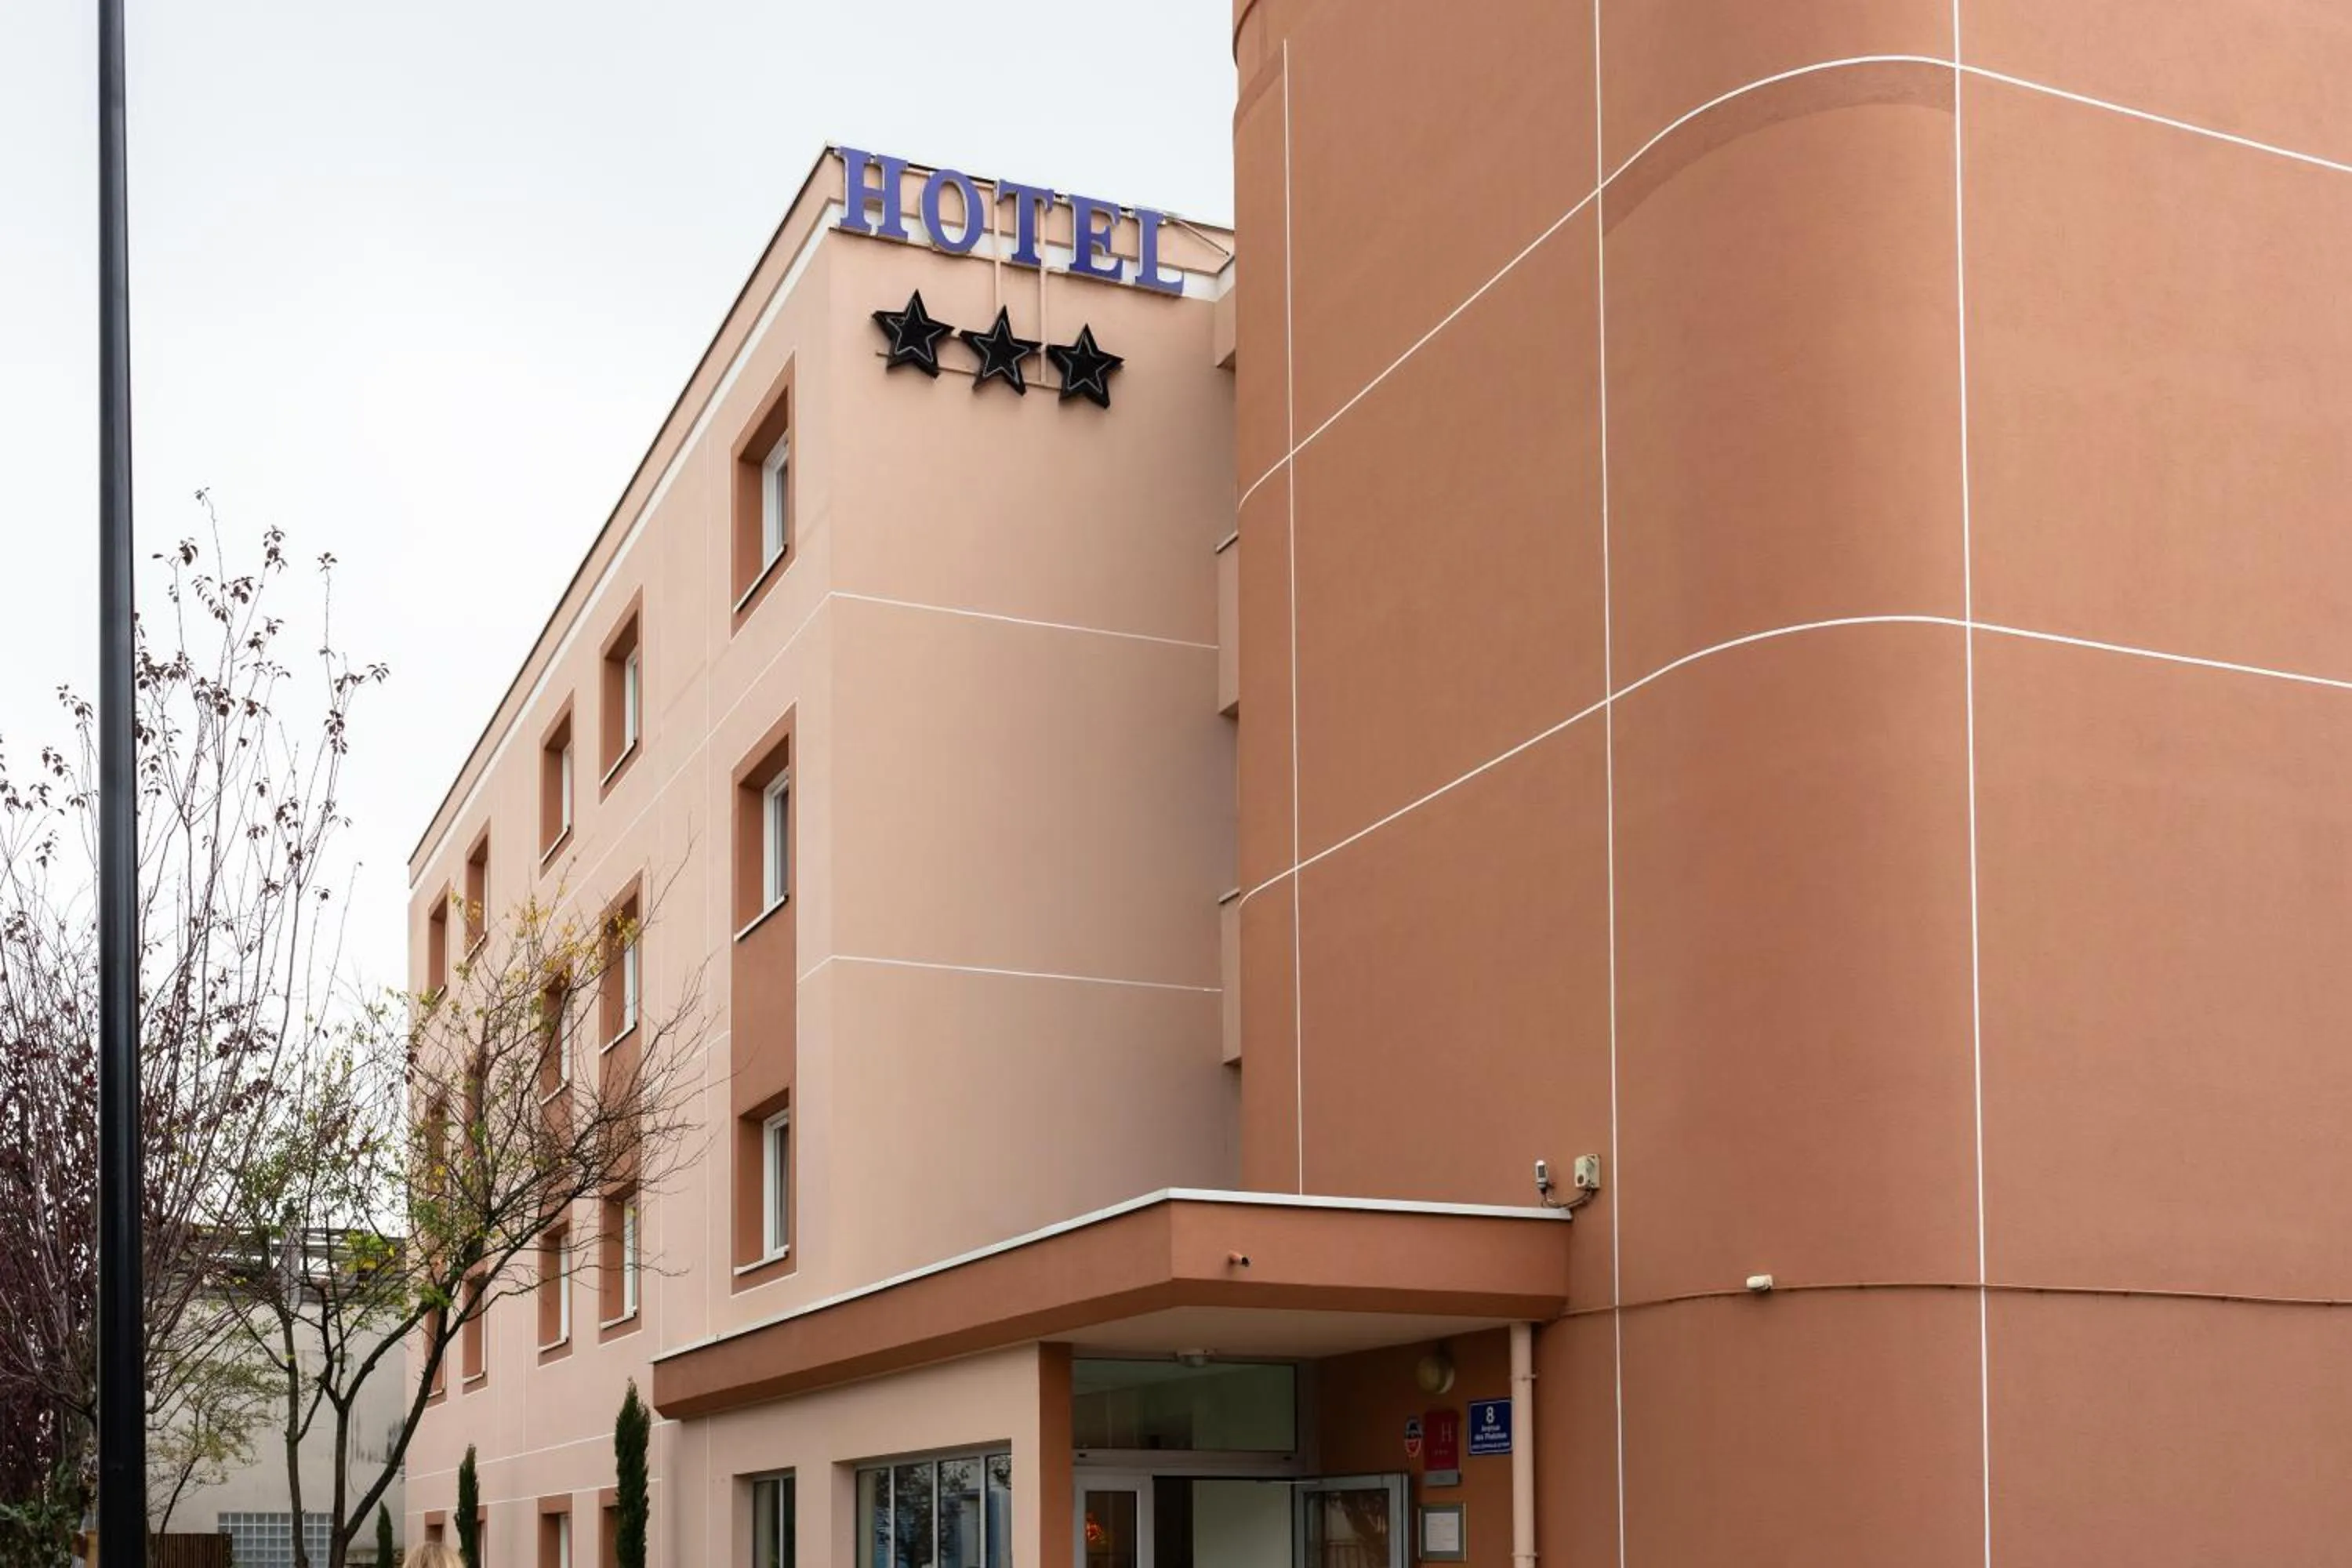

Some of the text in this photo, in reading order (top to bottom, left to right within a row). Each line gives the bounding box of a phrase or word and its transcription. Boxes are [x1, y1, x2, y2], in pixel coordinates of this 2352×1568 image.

[838, 145, 1185, 296] HOTEL
[1486, 1406, 1495, 1424] 8
[1441, 1422, 1452, 1443] H
